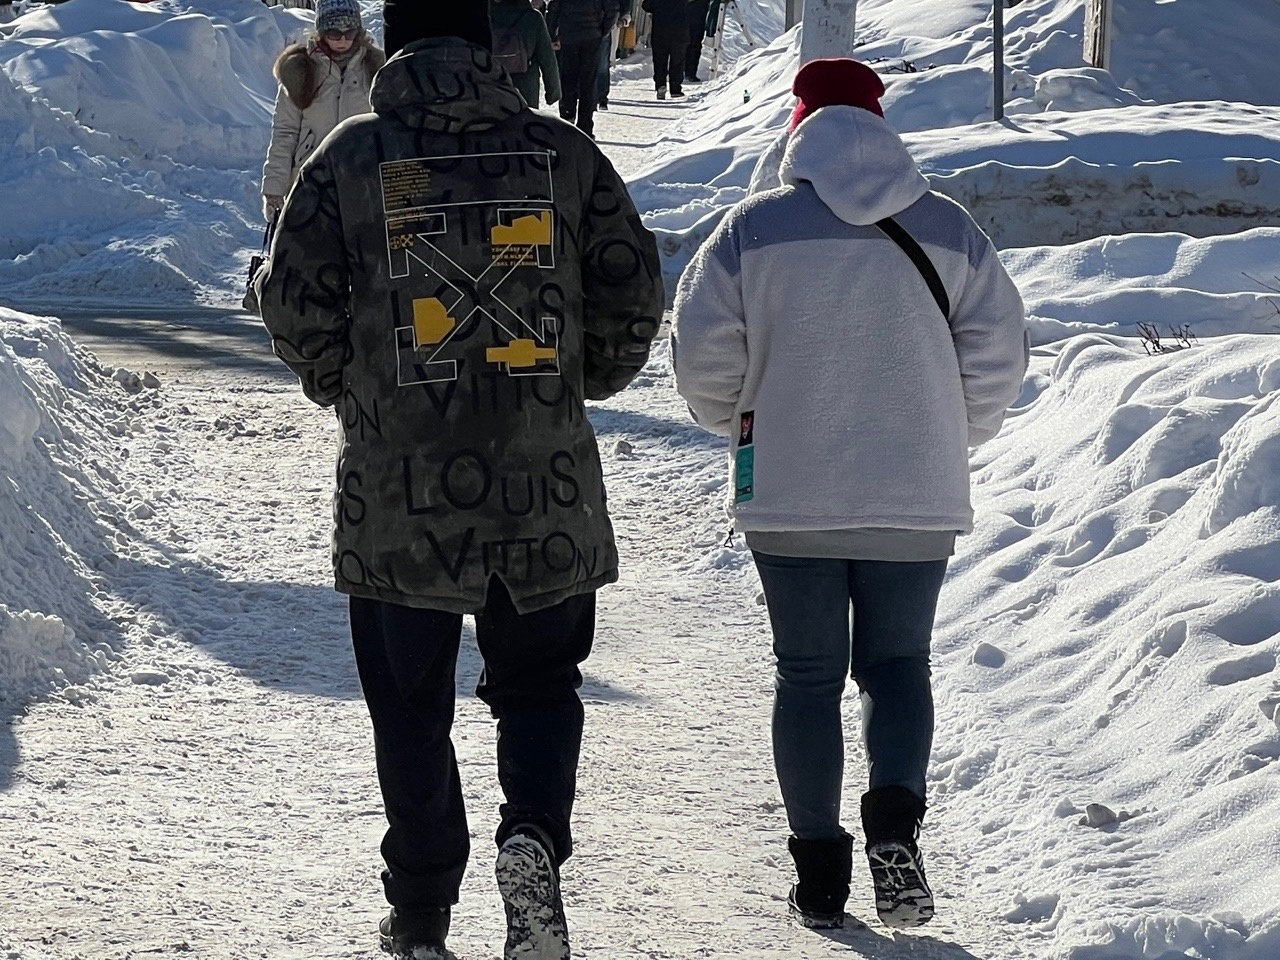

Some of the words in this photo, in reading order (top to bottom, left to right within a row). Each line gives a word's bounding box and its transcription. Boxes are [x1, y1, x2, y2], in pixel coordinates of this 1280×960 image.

[390, 279, 566, 351] LOUIS
[413, 358, 584, 422] VITTON
[402, 447, 580, 517] LOUIS
[424, 527, 597, 585] VITTON
